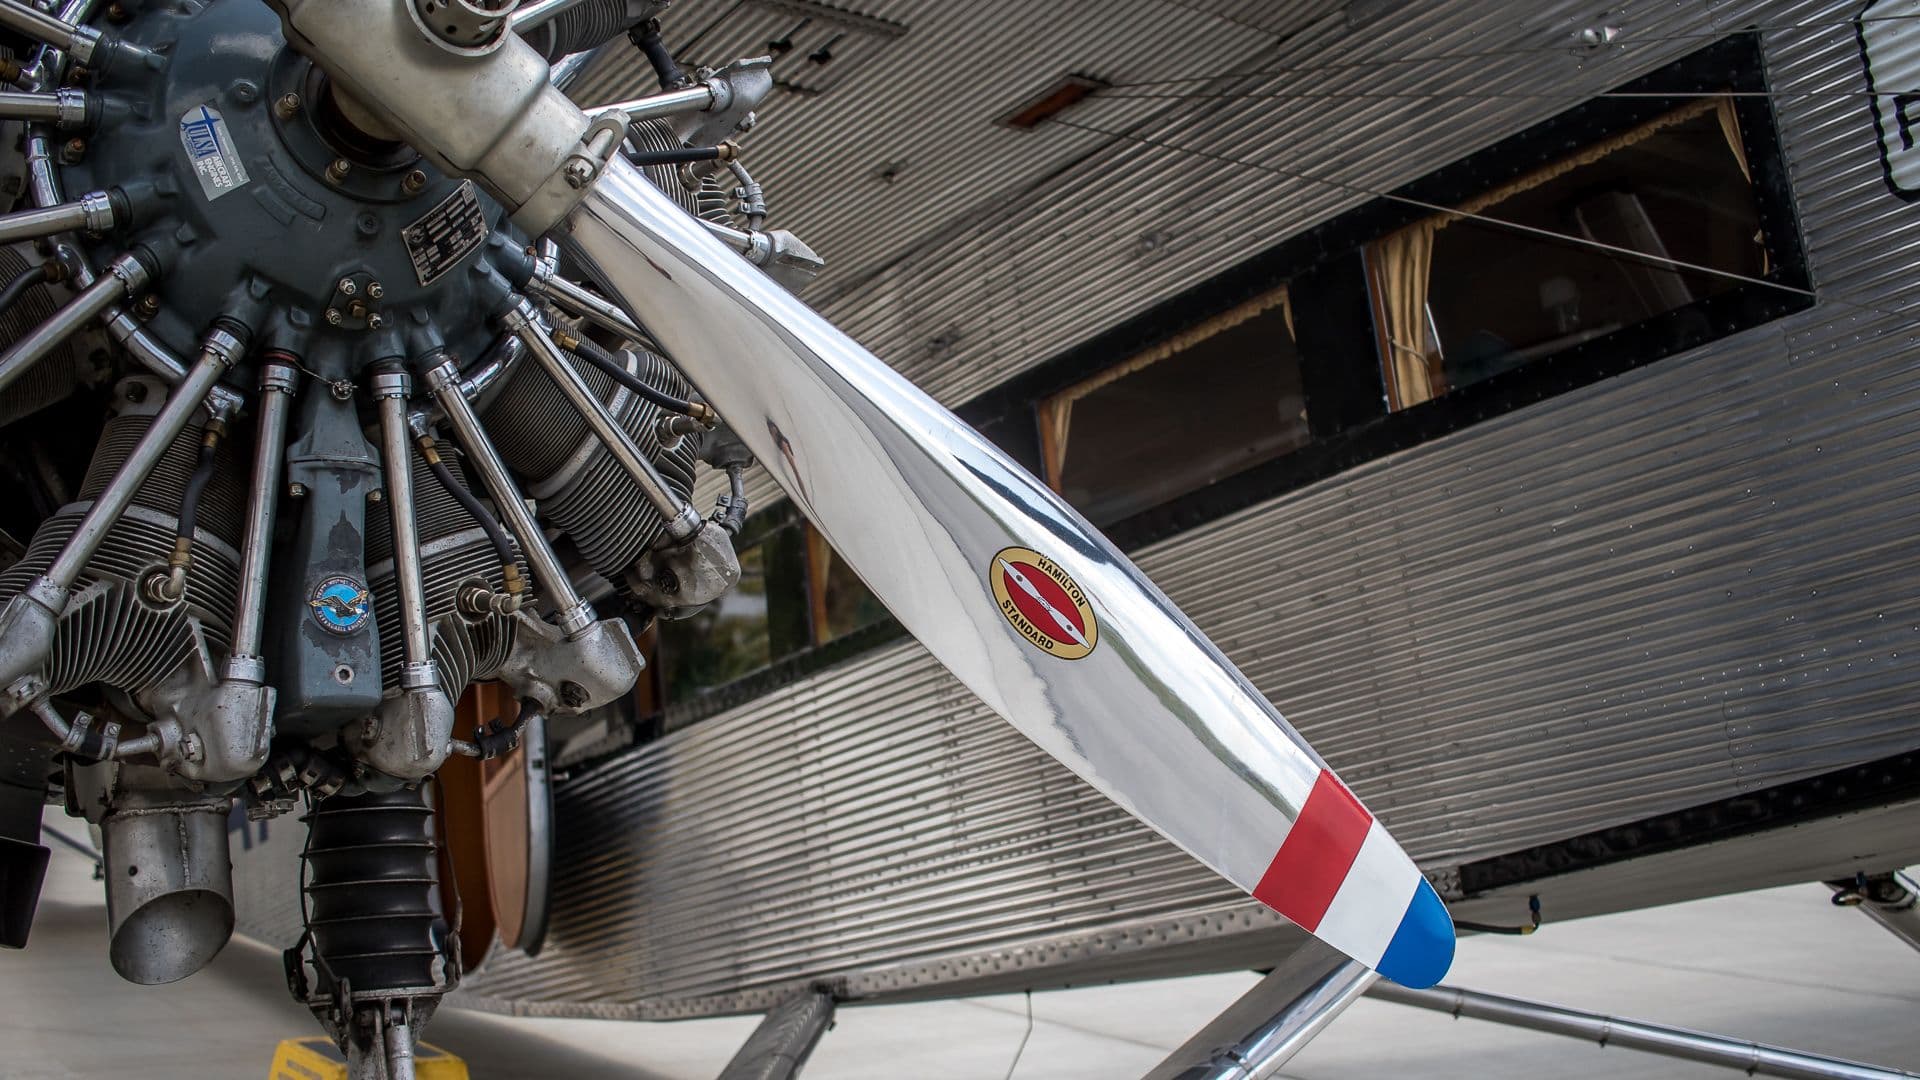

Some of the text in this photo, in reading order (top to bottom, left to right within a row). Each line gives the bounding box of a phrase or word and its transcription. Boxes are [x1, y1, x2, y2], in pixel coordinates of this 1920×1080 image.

[181, 105, 221, 159] TULSA
[204, 158, 223, 188] ENGINES
[212, 156, 232, 188] AIRCRAFT
[1037, 559, 1085, 607] HAMILTON
[1002, 599, 1054, 650] STANDARD
